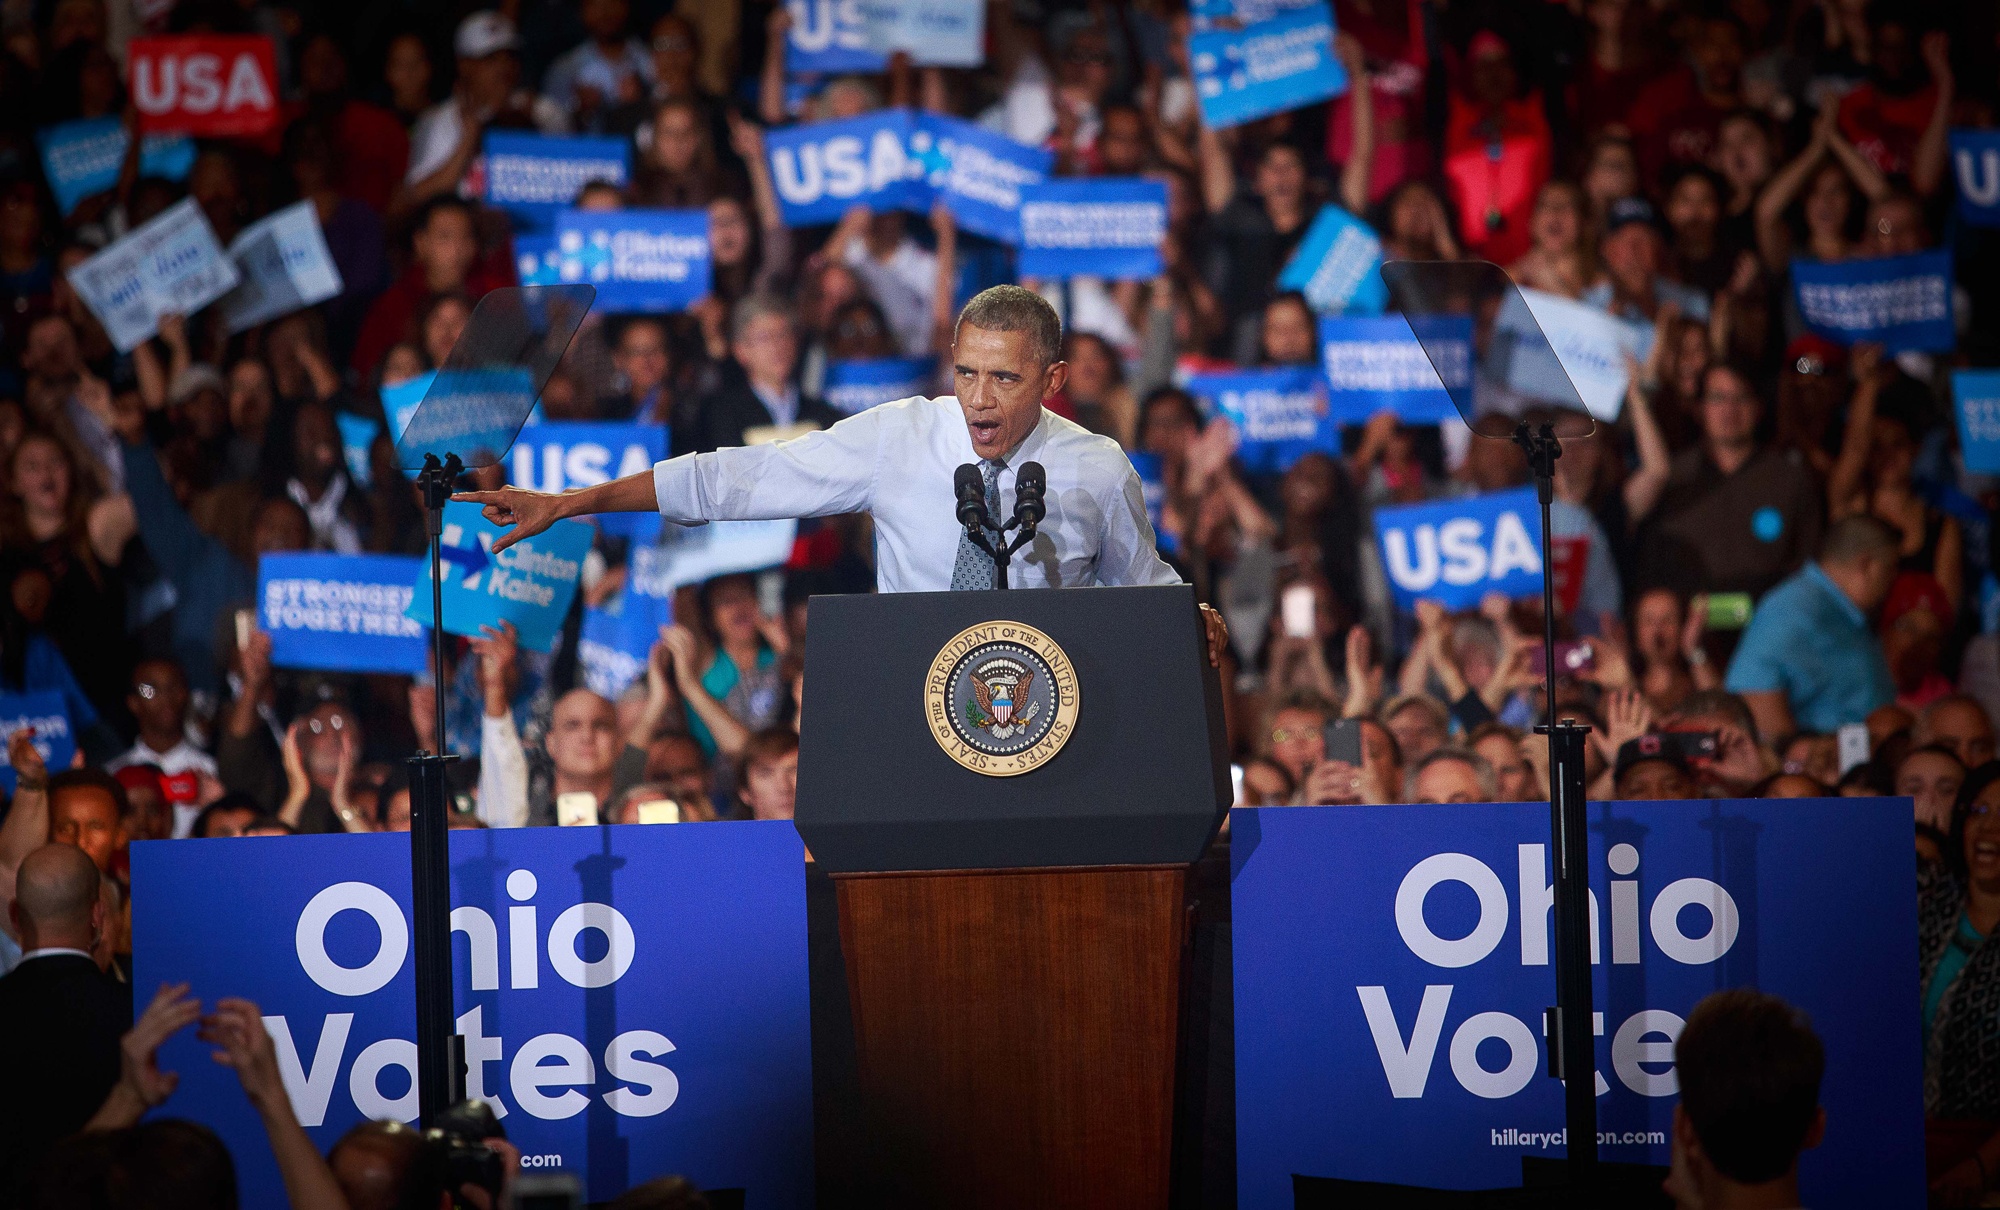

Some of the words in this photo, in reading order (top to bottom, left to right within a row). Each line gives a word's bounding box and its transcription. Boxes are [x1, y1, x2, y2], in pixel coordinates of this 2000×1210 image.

[132, 54, 272, 113] USA
[772, 130, 906, 204] USA
[496, 542, 579, 582] Clinton
[1384, 510, 1543, 592] USA
[487, 567, 555, 607] Kaine
[1002, 628, 1016, 638] OF
[1019, 630, 1039, 646] THE
[930, 626, 998, 696] PRESIDENT
[1042, 643, 1075, 707] UNITED
[932, 701, 945, 723] THE
[938, 725, 951, 739] OF
[951, 736, 989, 768] SEAL
[1016, 720, 1068, 768] STATES
[1395, 843, 1739, 968] Ohio
[259, 1004, 679, 1127] Votes
[1356, 984, 1681, 1099] Voe
[1491, 1128, 1665, 1149] hillaryclon.com
